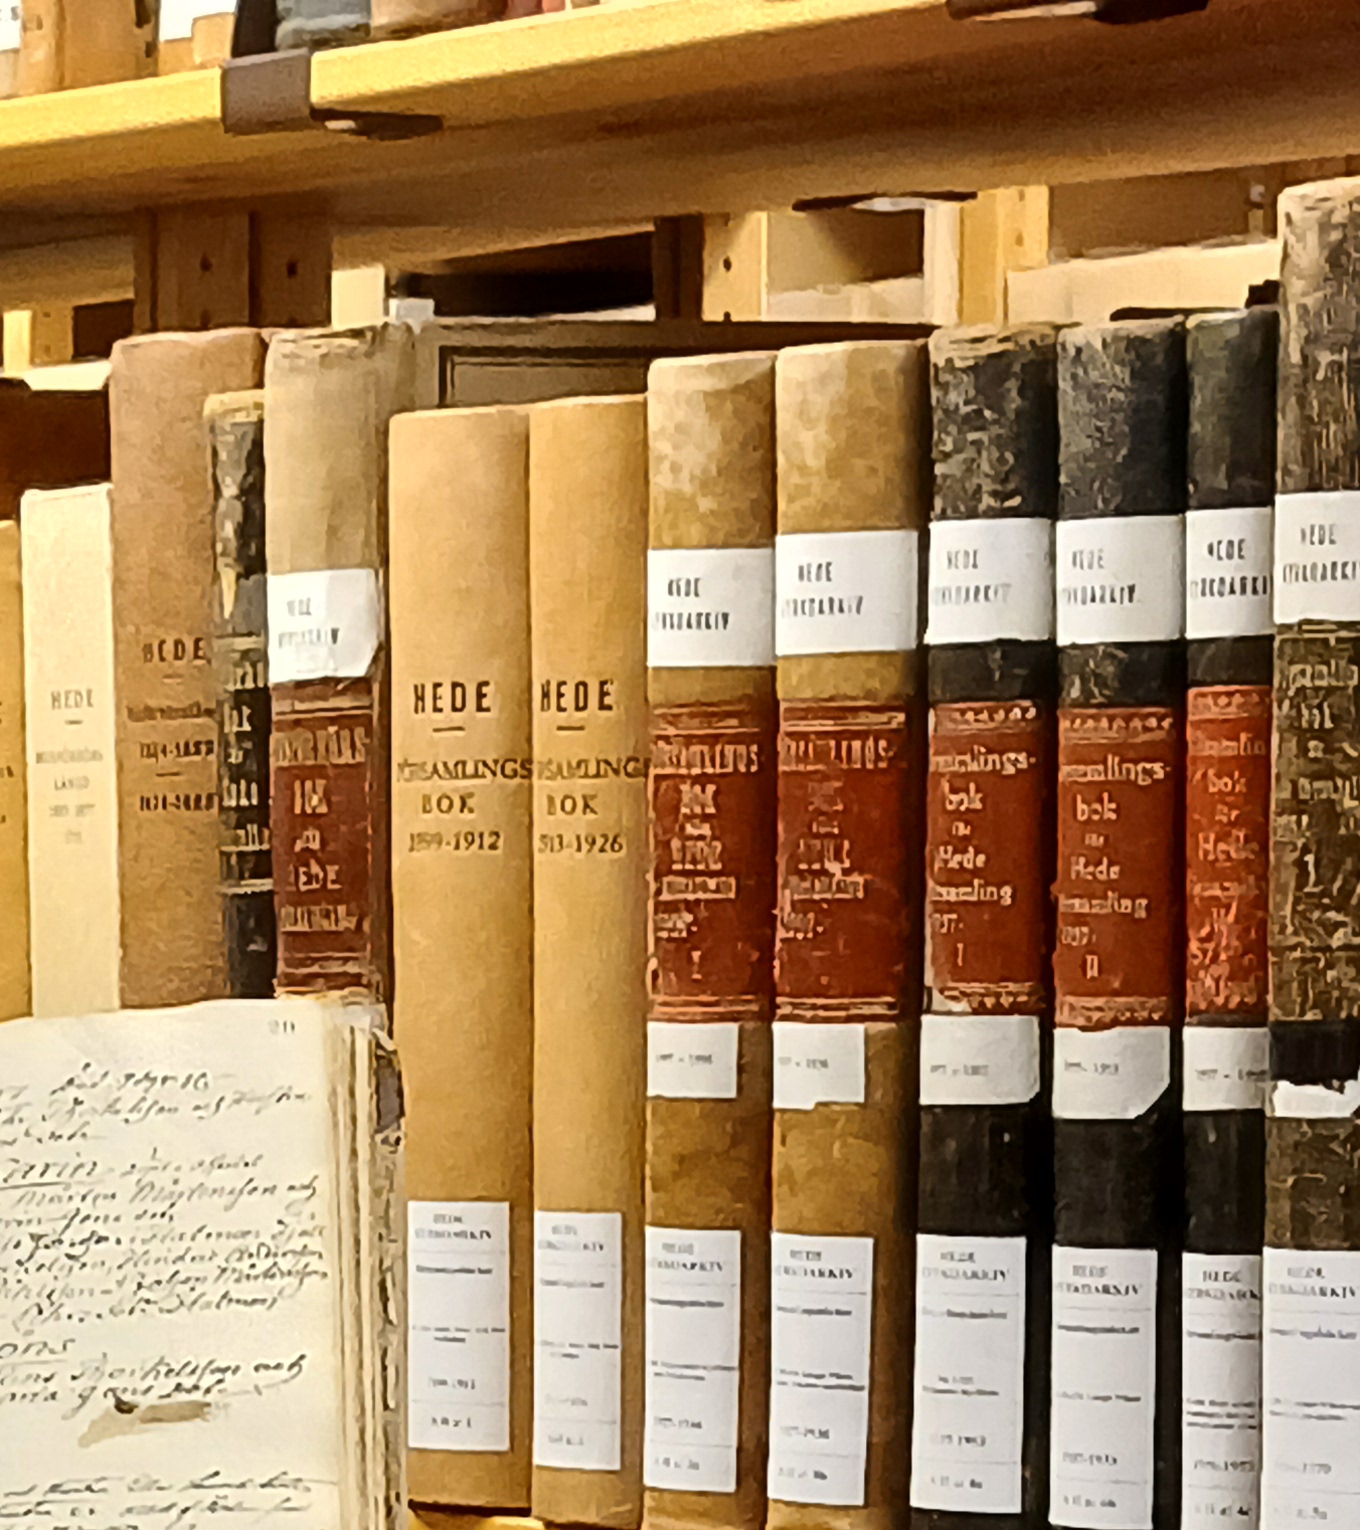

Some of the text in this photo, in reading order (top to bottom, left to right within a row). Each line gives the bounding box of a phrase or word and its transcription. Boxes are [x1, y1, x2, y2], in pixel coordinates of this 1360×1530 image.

[413, 681, 491, 714] HEDE
[541, 680, 614, 712] HEDE
[1076, 792, 1117, 821] bok
[937, 846, 986, 872] Hede
[1070, 856, 1120, 881] Hede
